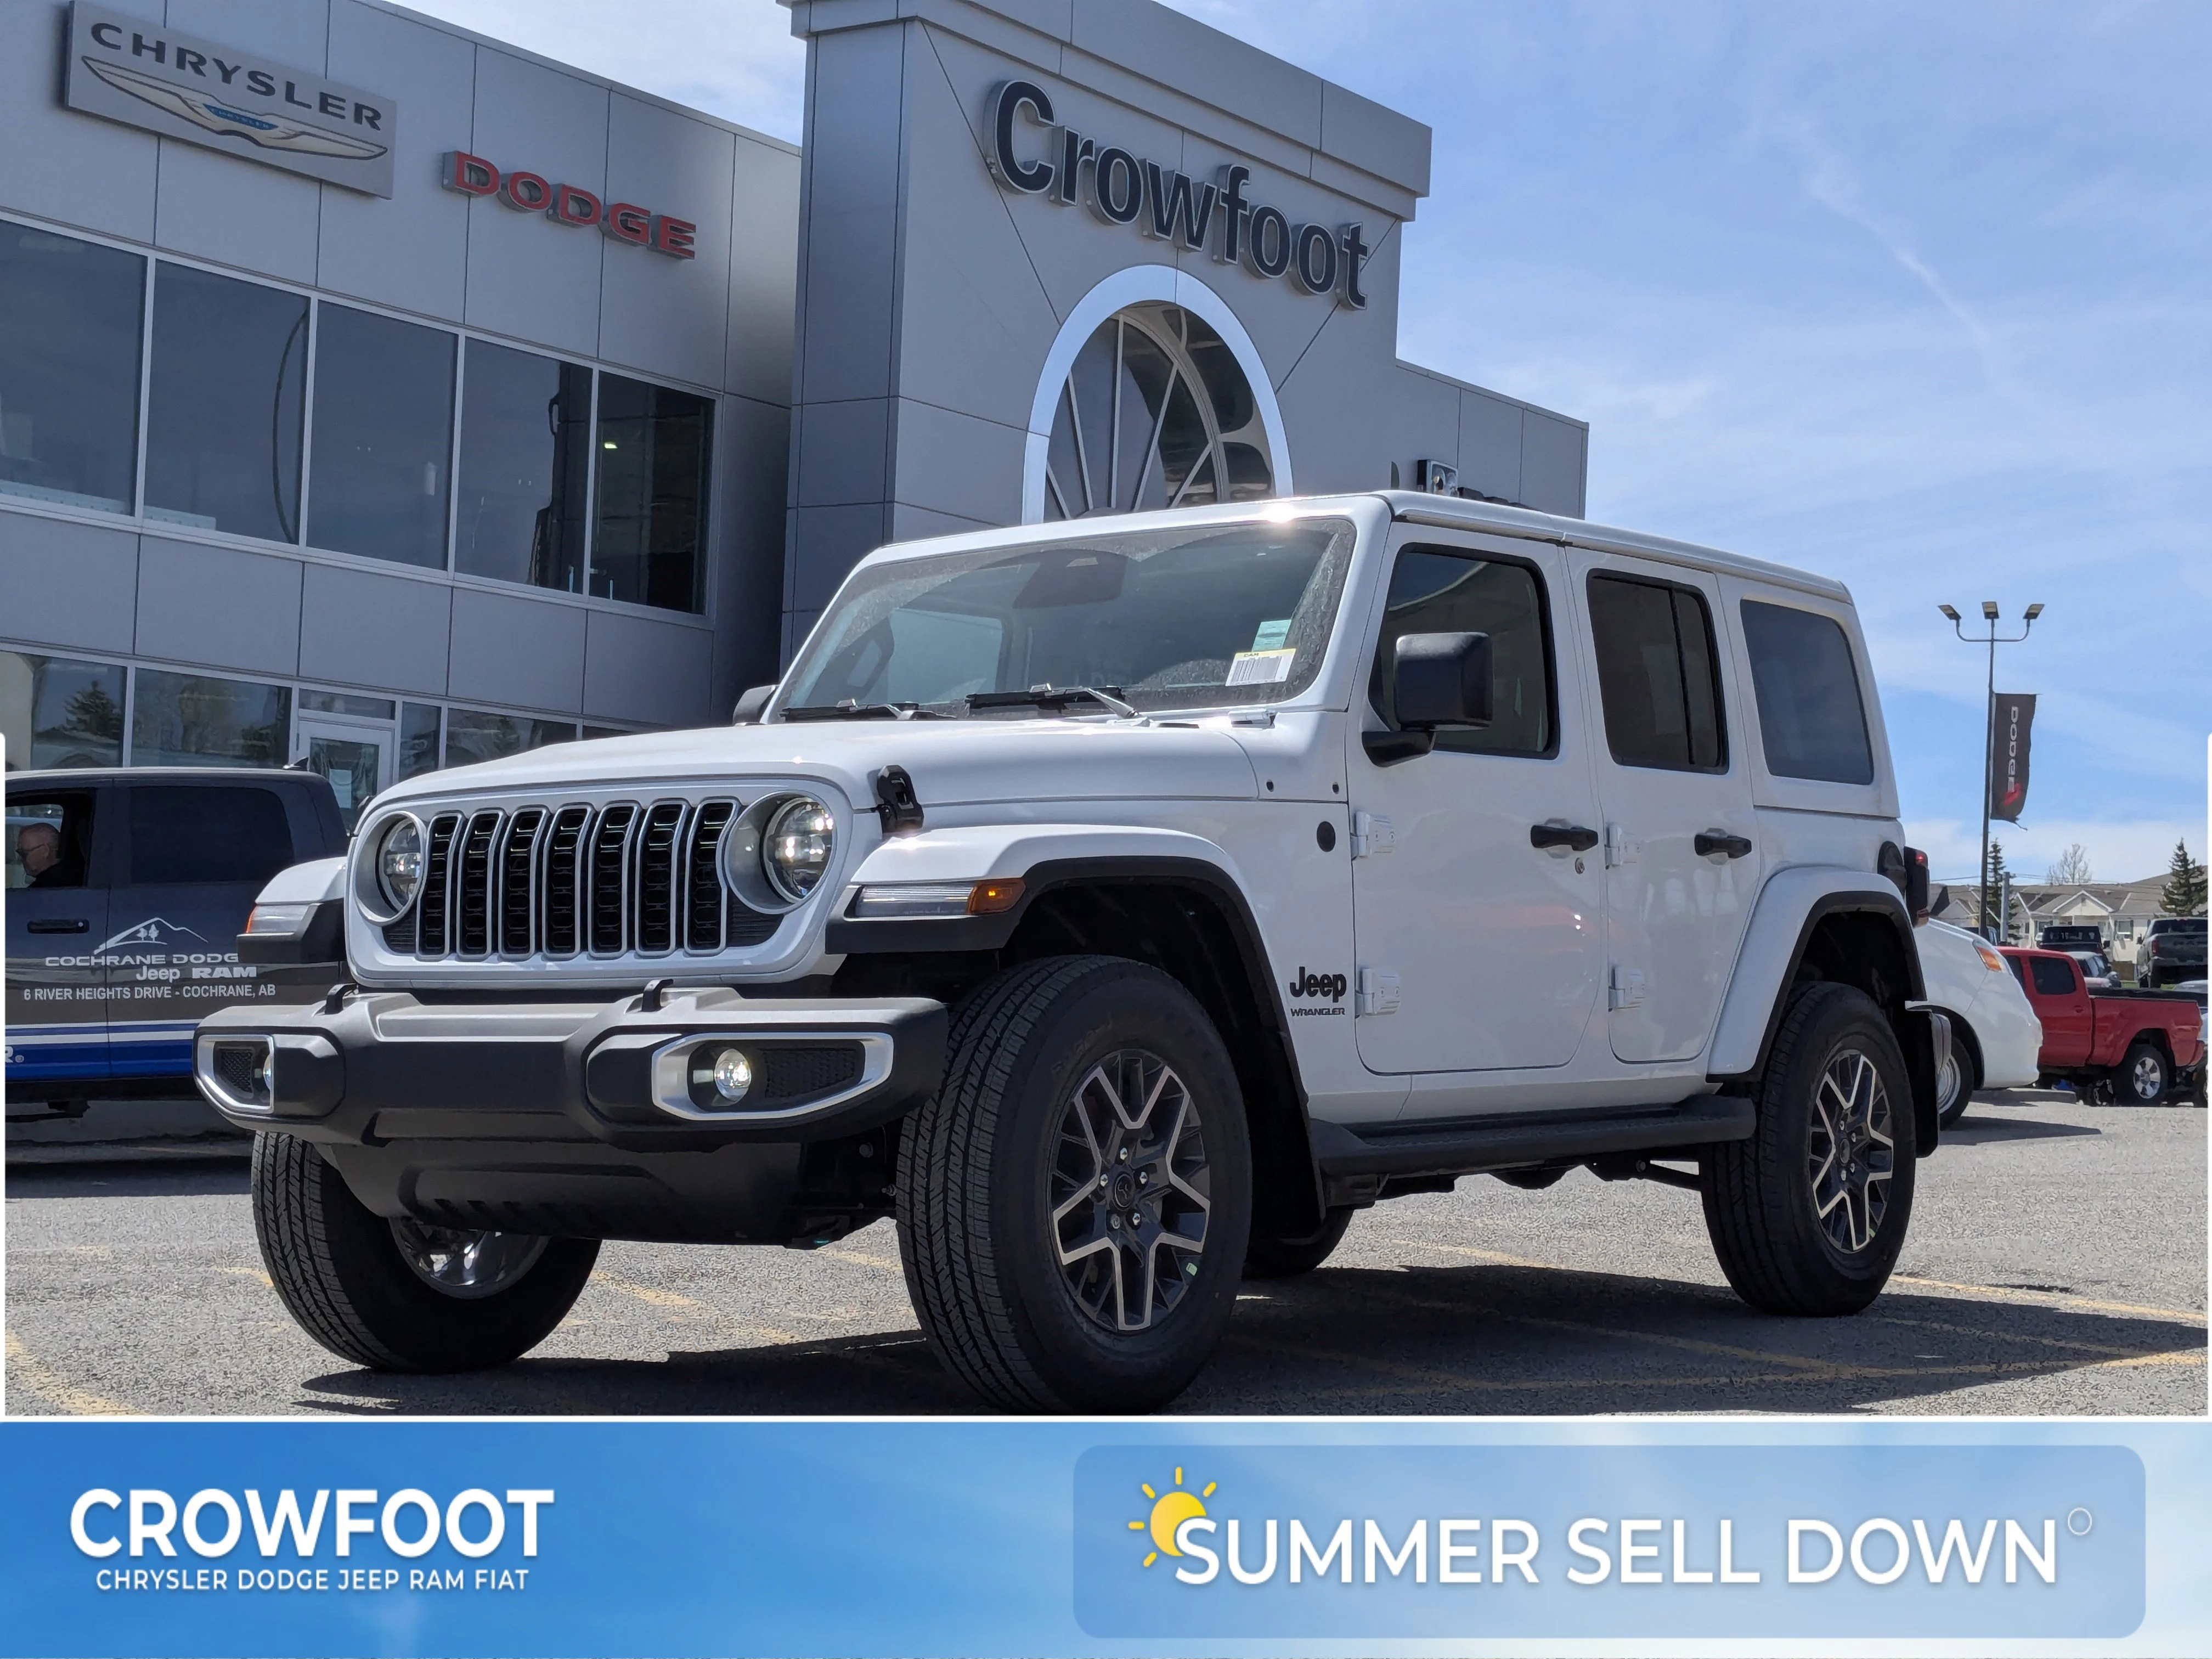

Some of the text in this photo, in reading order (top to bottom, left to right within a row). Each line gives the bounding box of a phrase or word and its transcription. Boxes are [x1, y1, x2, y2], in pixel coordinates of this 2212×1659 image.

[91, 22, 382, 131] CHRYSLER
[454, 150, 697, 259] DODGE
[992, 79, 1369, 311] Crowfoot
[45, 953, 239, 966] COCHRANE DODG
[136, 966, 257, 983] Jeep RAM
[1289, 966, 1347, 1003] Jeep
[24, 989, 31, 1001] 6
[34, 988, 73, 1001] RIVER
[76, 987, 131, 1000] HEIGHTS
[134, 986, 172, 999] DRIVE
[182, 985, 256, 998] COCHRANE,
[258, 984, 276, 996] AB
[1290, 1007, 1346, 1017] WRANGLER
